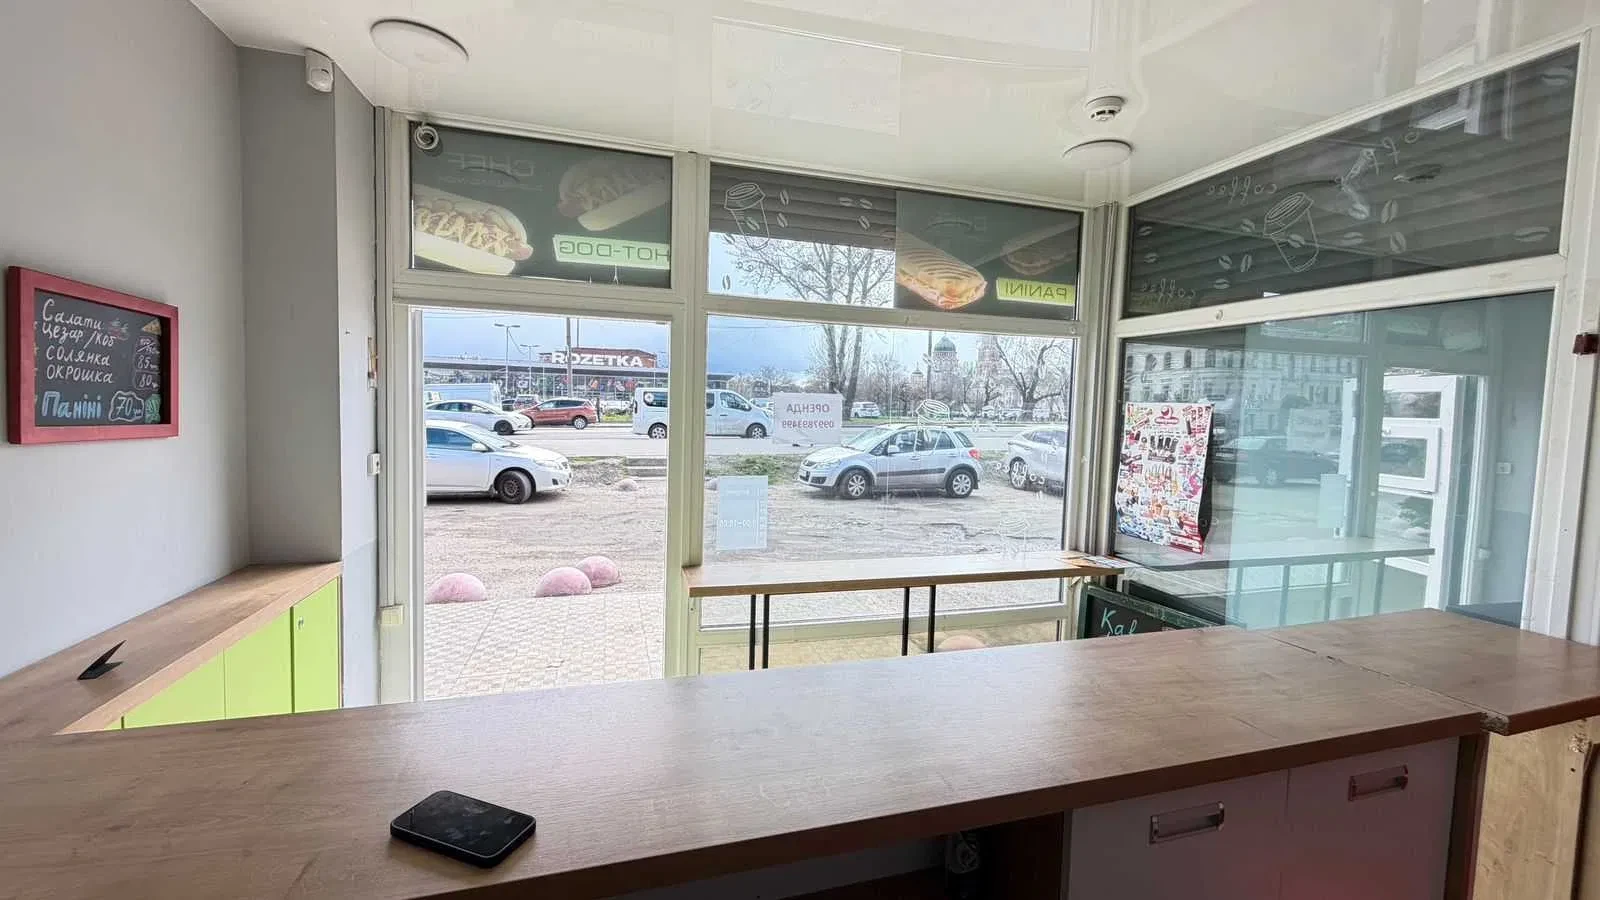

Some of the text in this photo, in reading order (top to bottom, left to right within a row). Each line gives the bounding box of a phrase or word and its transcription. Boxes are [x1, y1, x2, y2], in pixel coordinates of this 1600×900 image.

[42, 298, 103, 330] Салати
[551, 351, 643, 367] ROZETKA
[41, 390, 102, 419] Паніні
